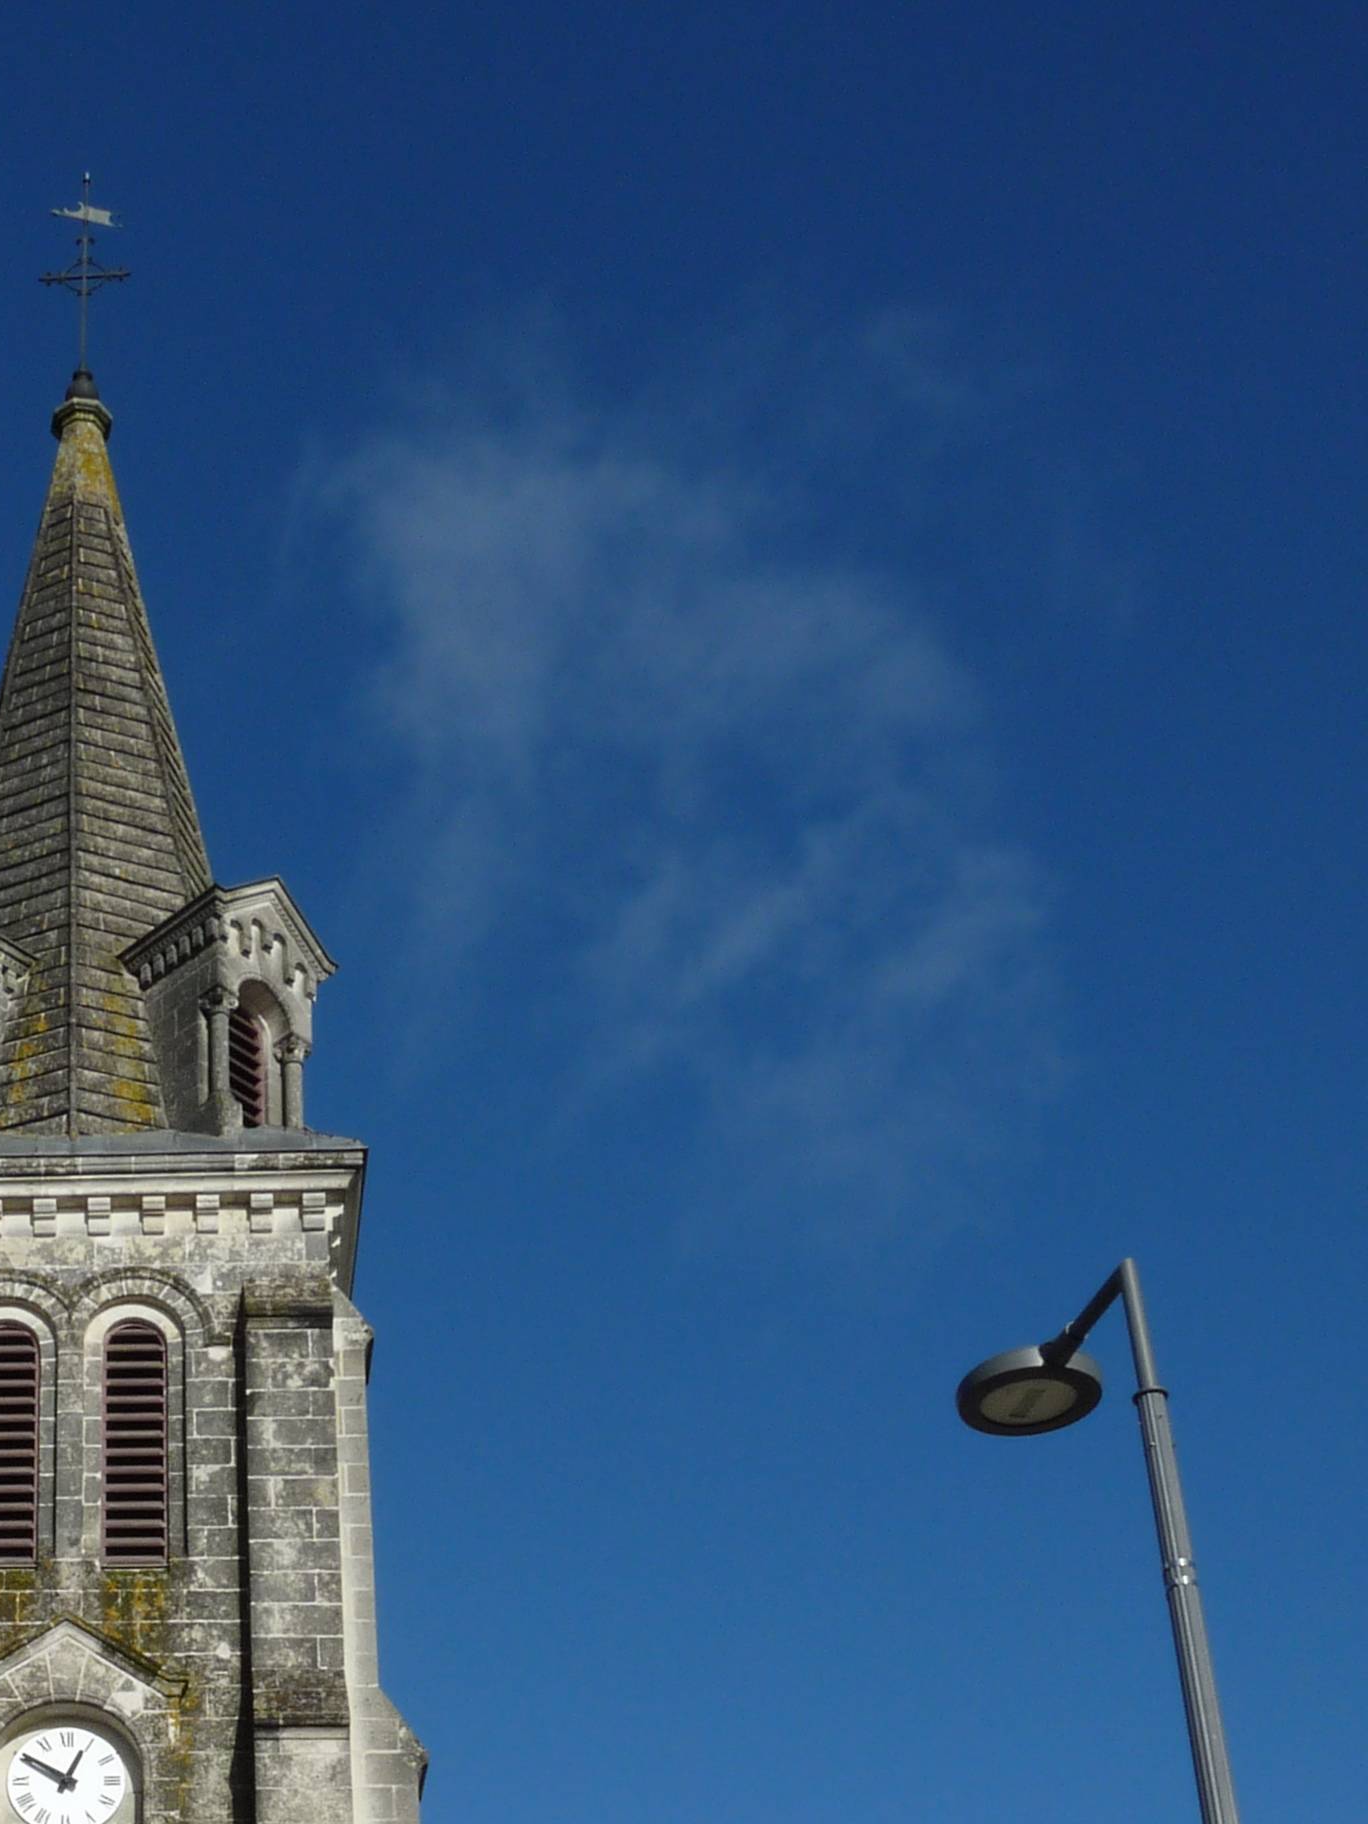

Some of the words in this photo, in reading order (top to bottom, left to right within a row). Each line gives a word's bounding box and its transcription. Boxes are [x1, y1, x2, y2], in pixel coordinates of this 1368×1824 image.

[36, 1737, 52, 1752] XI
[59, 1731, 74, 1748] XII
[97, 1754, 115, 1766] II
[104, 1776, 121, 1786] III
